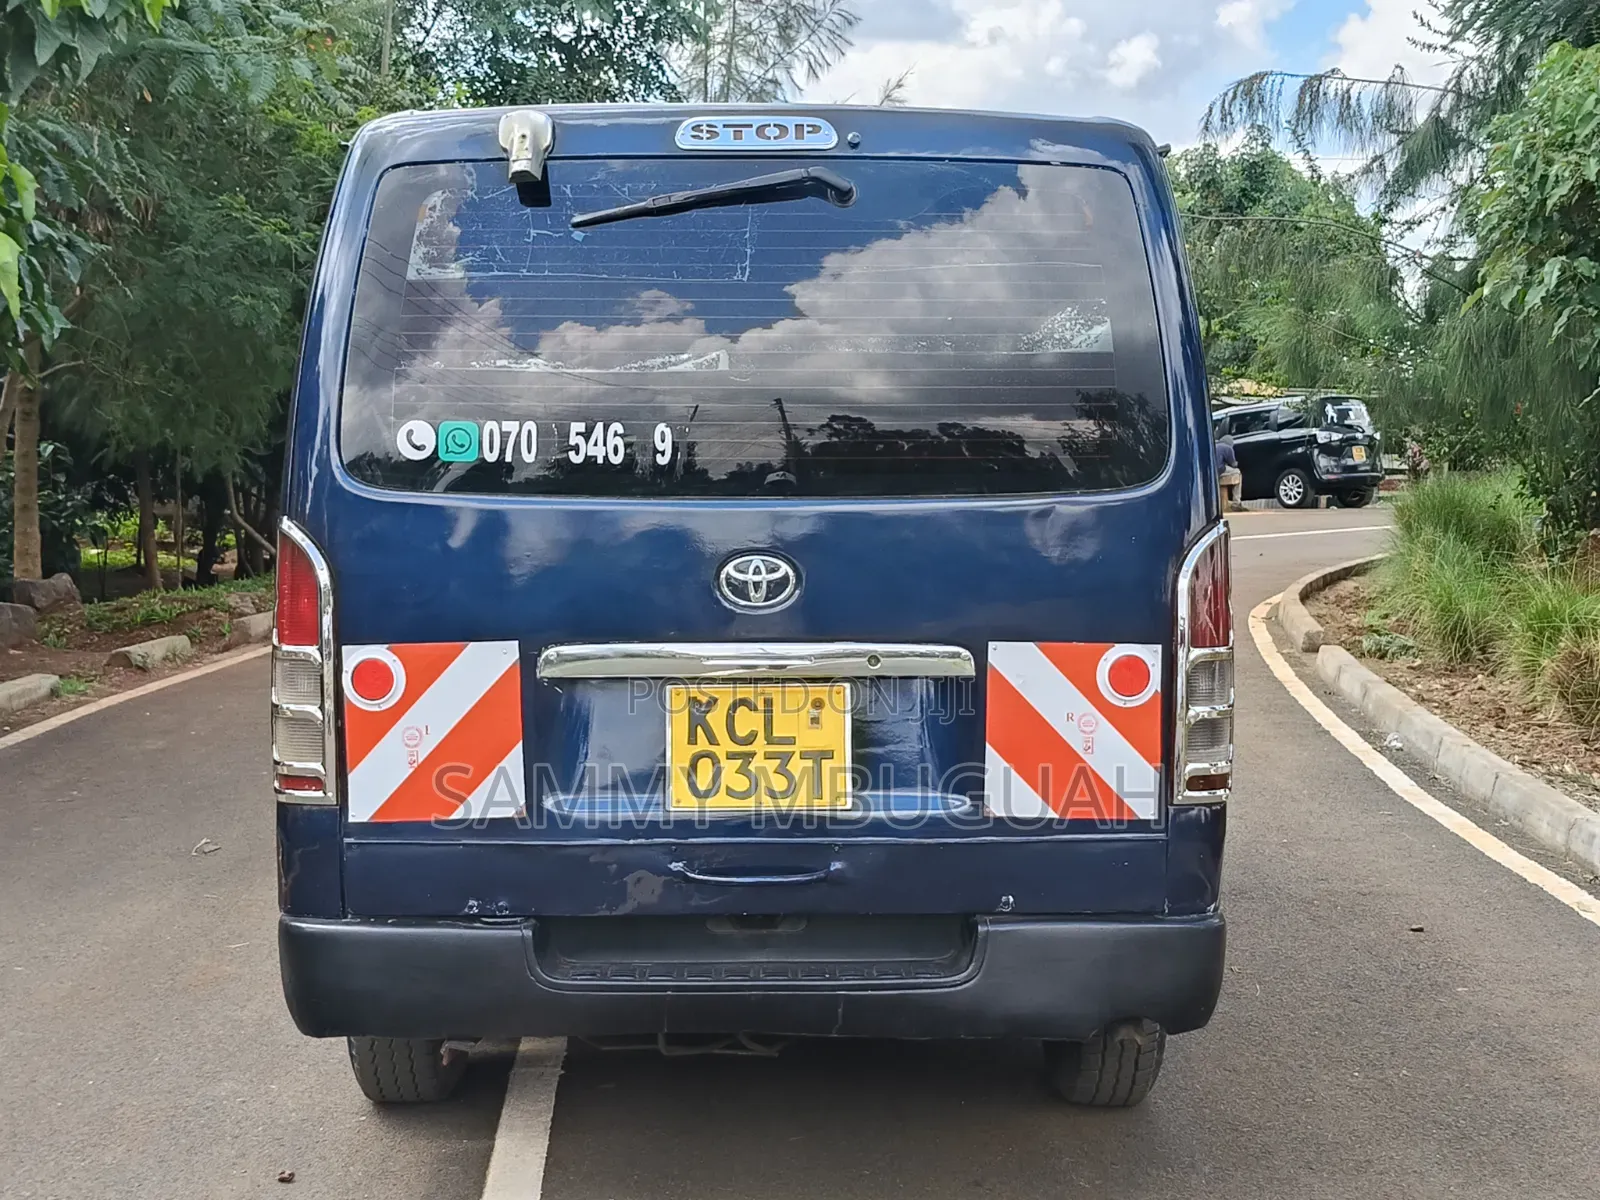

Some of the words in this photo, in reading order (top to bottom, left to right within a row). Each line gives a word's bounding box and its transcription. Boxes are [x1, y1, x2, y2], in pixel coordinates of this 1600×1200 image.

[690, 123, 823, 141] STOP
[482, 420, 538, 463] 070
[567, 421, 625, 465] 546
[654, 422, 673, 465] 9
[686, 696, 797, 746] KCL
[1066, 712, 1075, 722] R
[686, 749, 834, 801] 033T
